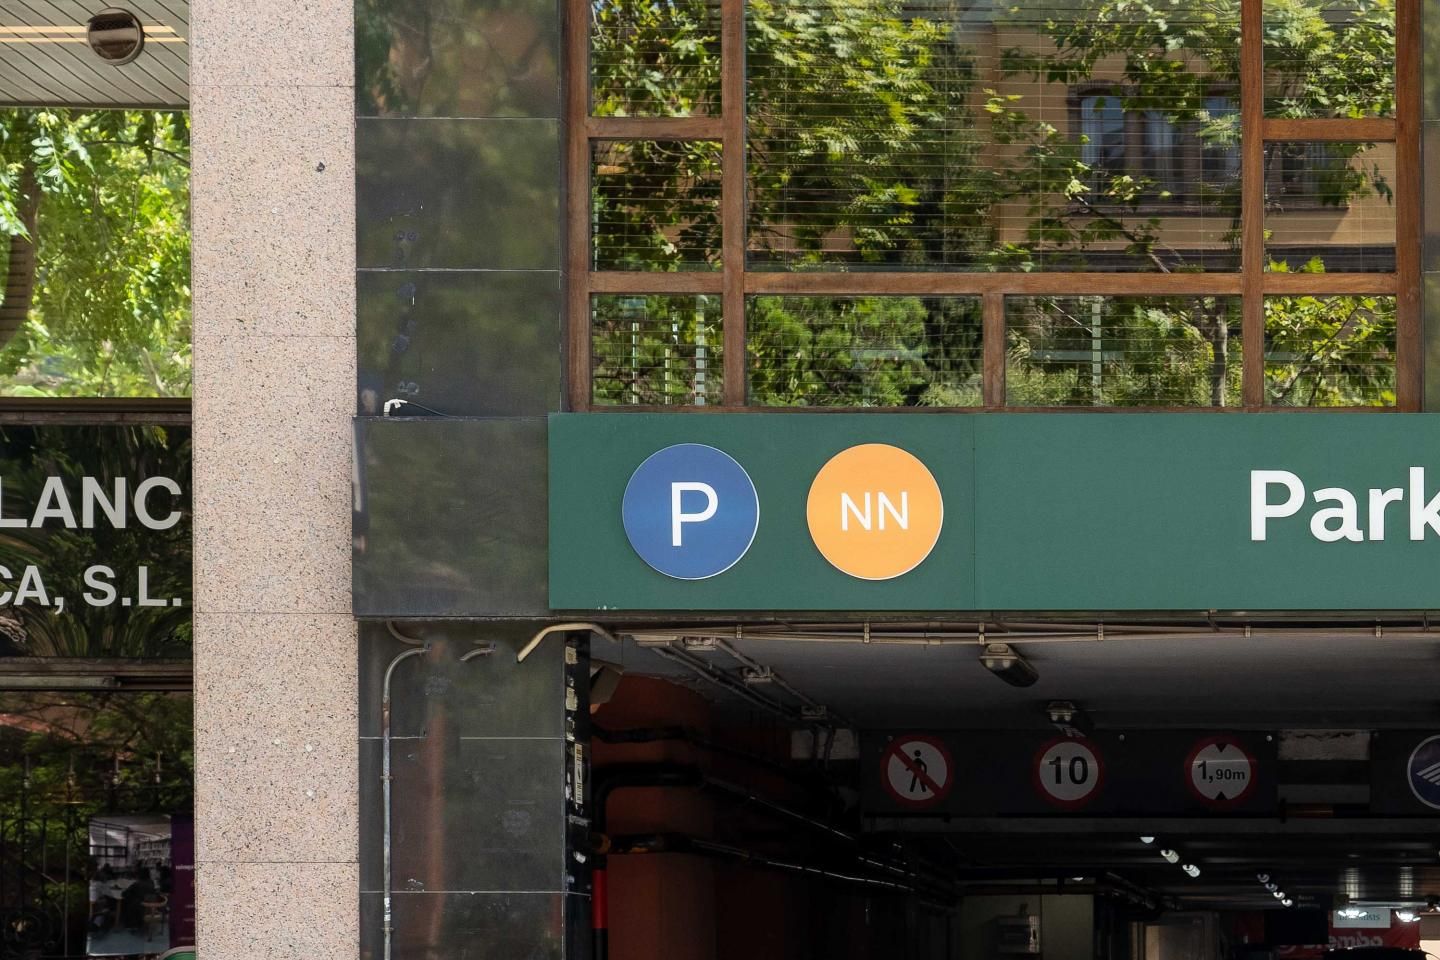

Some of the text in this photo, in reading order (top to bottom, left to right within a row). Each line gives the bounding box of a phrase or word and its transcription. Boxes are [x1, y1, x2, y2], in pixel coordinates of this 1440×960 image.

[671, 481, 719, 547] P
[841, 491, 908, 531] NN
[82, 565, 182, 607] S.L.
[1048, 755, 1089, 786] 10
